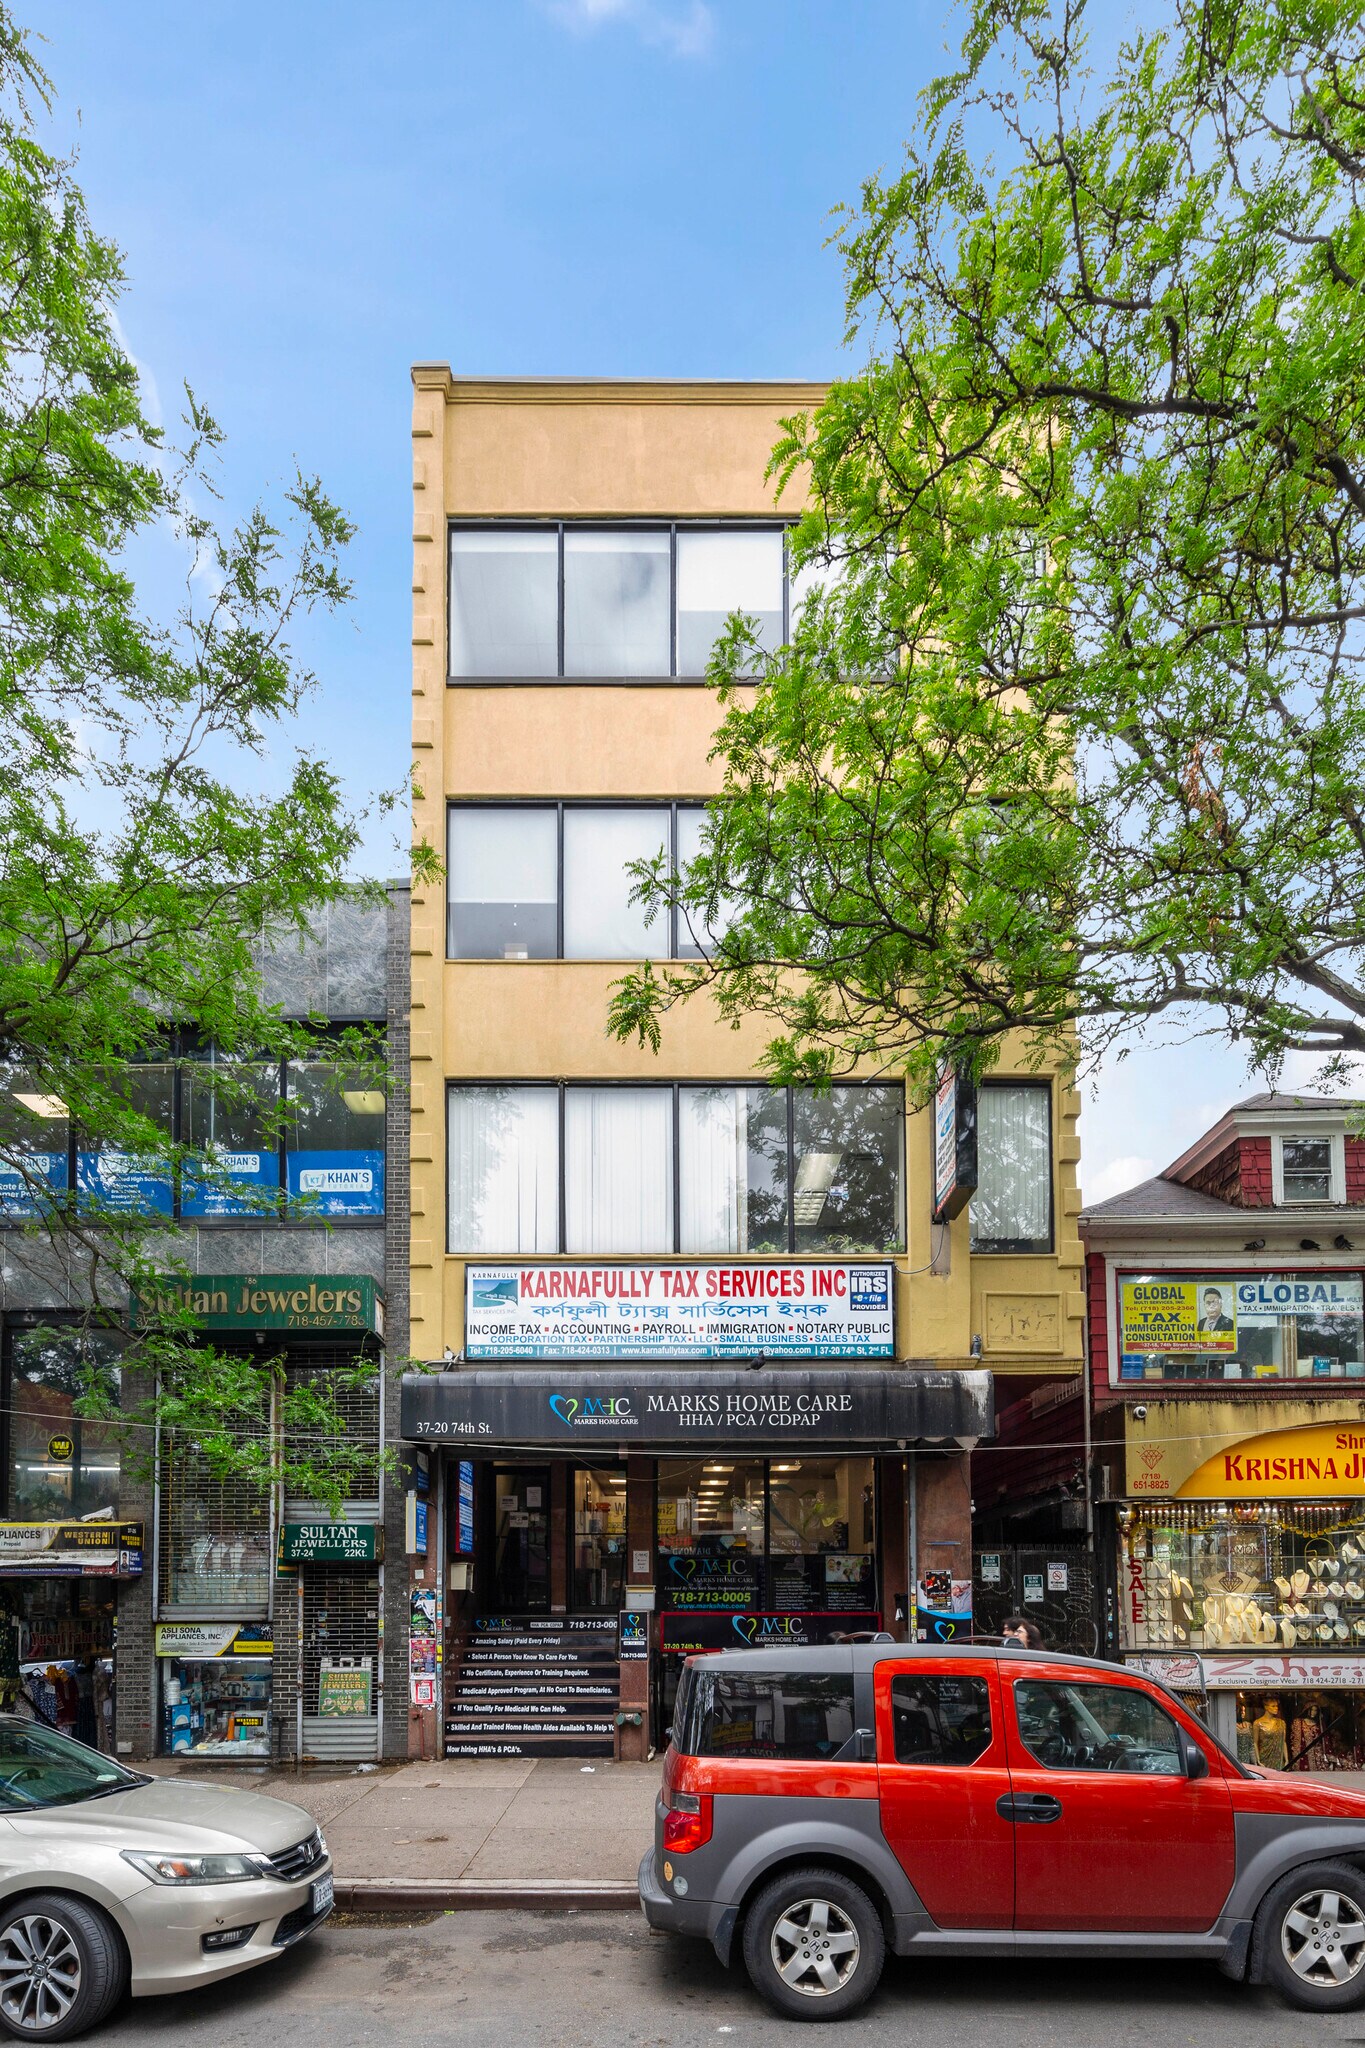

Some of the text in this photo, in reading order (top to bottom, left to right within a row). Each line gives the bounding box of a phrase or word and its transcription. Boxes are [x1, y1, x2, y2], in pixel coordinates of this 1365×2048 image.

[327, 1172, 370, 1183] KHAN'S
[520, 1270, 847, 1297] KARNAFULLY TAX SERVICES INC
[850, 1277, 887, 1293] IRS
[1133, 1286, 1185, 1300] GLOBAL
[1238, 1284, 1345, 1303] GLOBAL
[236, 1284, 362, 1314] Jewelers
[1138, 1312, 1181, 1323] TAX
[469, 1324, 891, 1335] INCOME TAX ACCOUNTING PAYROLL IMMIGRATION NOTARY PUBLIC
[1125, 1323, 1195, 1332] IMMIGRATION
[490, 1335, 870, 1343] CORPORATION TAX PARTNERSHIP TAX LLC SMALL BUSINESS SALES TAX
[1125, 1333, 1195, 1341] CONSULTATION
[470, 1346, 483, 1355] Tel:
[484, 1346, 534, 1355] 718-205-6040
[543, 1346, 560, 1355] Fax:
[561, 1346, 610, 1355] 718-424-0313
[621, 1346, 707, 1356] www.karnafullytax.com
[820, 1346, 840, 1355] 37-20
[841, 1346, 856, 1355] 74th
[868, 1346, 879, 1355] 2nd
[880, 1346, 890, 1355] FL
[582, 1397, 631, 1415] MHC
[647, 1395, 853, 1412] MARKS HOME CARE
[679, 1413, 821, 1426] HHA PCA CDPAP
[416, 1422, 493, 1434] 37-20 74th St.
[1224, 1455, 1338, 1481] KRISHNA
[1133, 1480, 1170, 1490] 651-8825
[0, 1531, 41, 1539] PLIANCES
[299, 1526, 358, 1539] SULTAN
[291, 1539, 368, 1548] JEWELLERS
[291, 1549, 368, 1557] 37-24 22Kt.
[1128, 1558, 1145, 1624] SALE
[672, 1592, 752, 1603] 718-713-0005
[761, 1617, 803, 1634] MHC
[623, 1627, 645, 1638] MHC
[475, 1637, 543, 1645] Amazing Salary Every
[471, 1653, 558, 1661] Select Person You Know Care
[474, 1669, 590, 1678] Certificate, Experience Training Required.
[1218, 1677, 1347, 1687] Exclusive Designer Wear 718 424-2718
[462, 1686, 613, 1695] Medicaid Approved Program, Cost Beneficiaries.
[462, 1704, 567, 1713] You Qualify For Medicaid Can Help.
[450, 1723, 608, 1734] Skilled And Trained Home Health Aides Available Help
[446, 1745, 497, 1755] Now hiring HHA's
